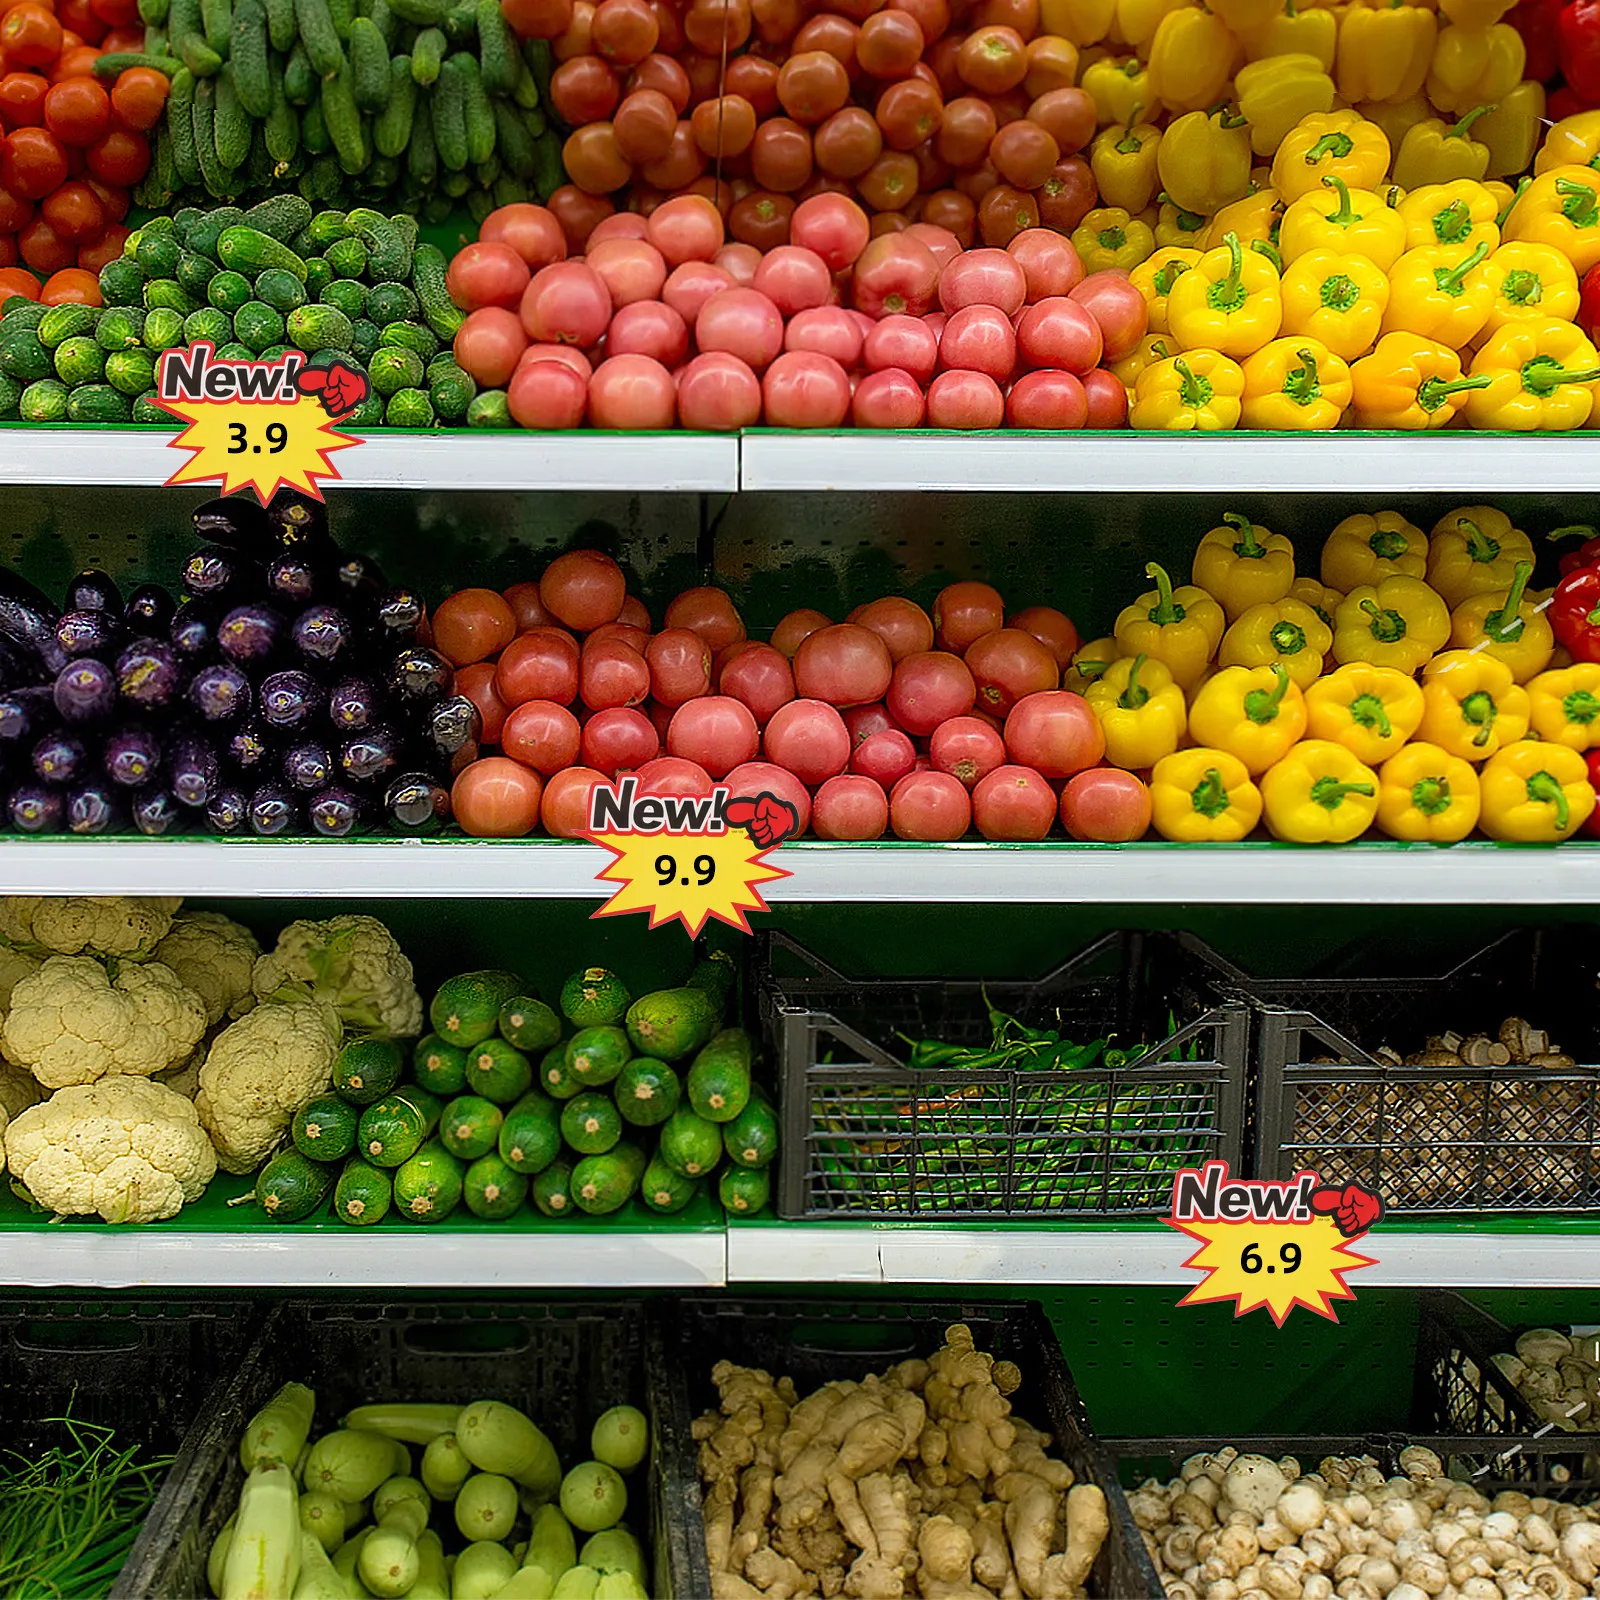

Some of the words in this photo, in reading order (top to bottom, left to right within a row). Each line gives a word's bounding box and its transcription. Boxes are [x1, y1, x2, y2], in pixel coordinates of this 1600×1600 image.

[164, 347, 299, 398] New!
[228, 423, 288, 454] 3.9
[592, 779, 727, 830] New!
[654, 854, 716, 886] 9.9
[1178, 1167, 1313, 1218] New!
[1240, 1242, 1302, 1274] 6.9
